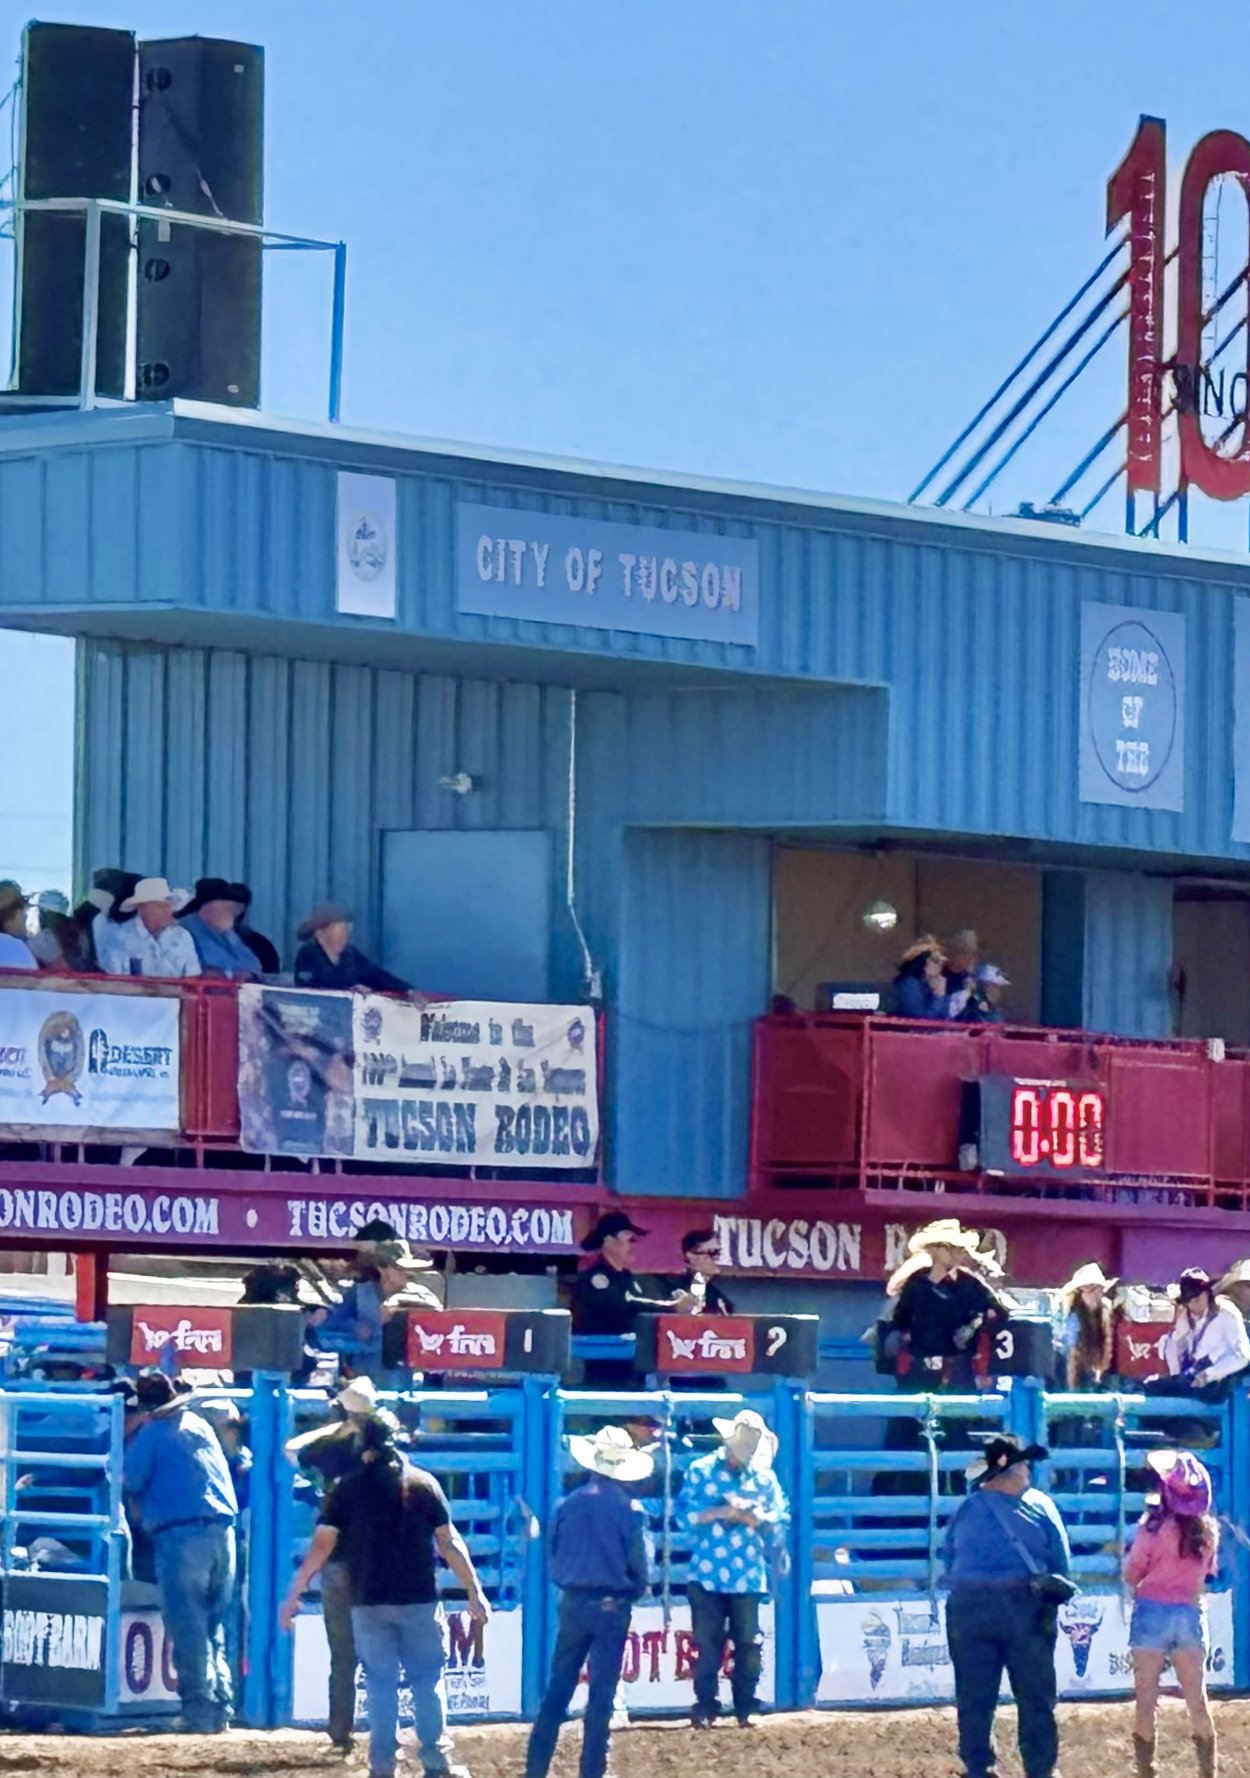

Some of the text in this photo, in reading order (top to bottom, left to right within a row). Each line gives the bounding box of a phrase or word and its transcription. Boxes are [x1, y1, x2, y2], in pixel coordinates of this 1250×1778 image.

[476, 534, 742, 613] CITY OF TUCSON
[1116, 739, 1150, 776] THE
[110, 1044, 173, 1067] DESERT
[362, 1097, 591, 1158] TUCSON RODEO
[287, 1199, 574, 1246] TUCSONRODEO.COM
[713, 1213, 862, 1273] TUCSON
[995, 1329, 1015, 1359] 3
